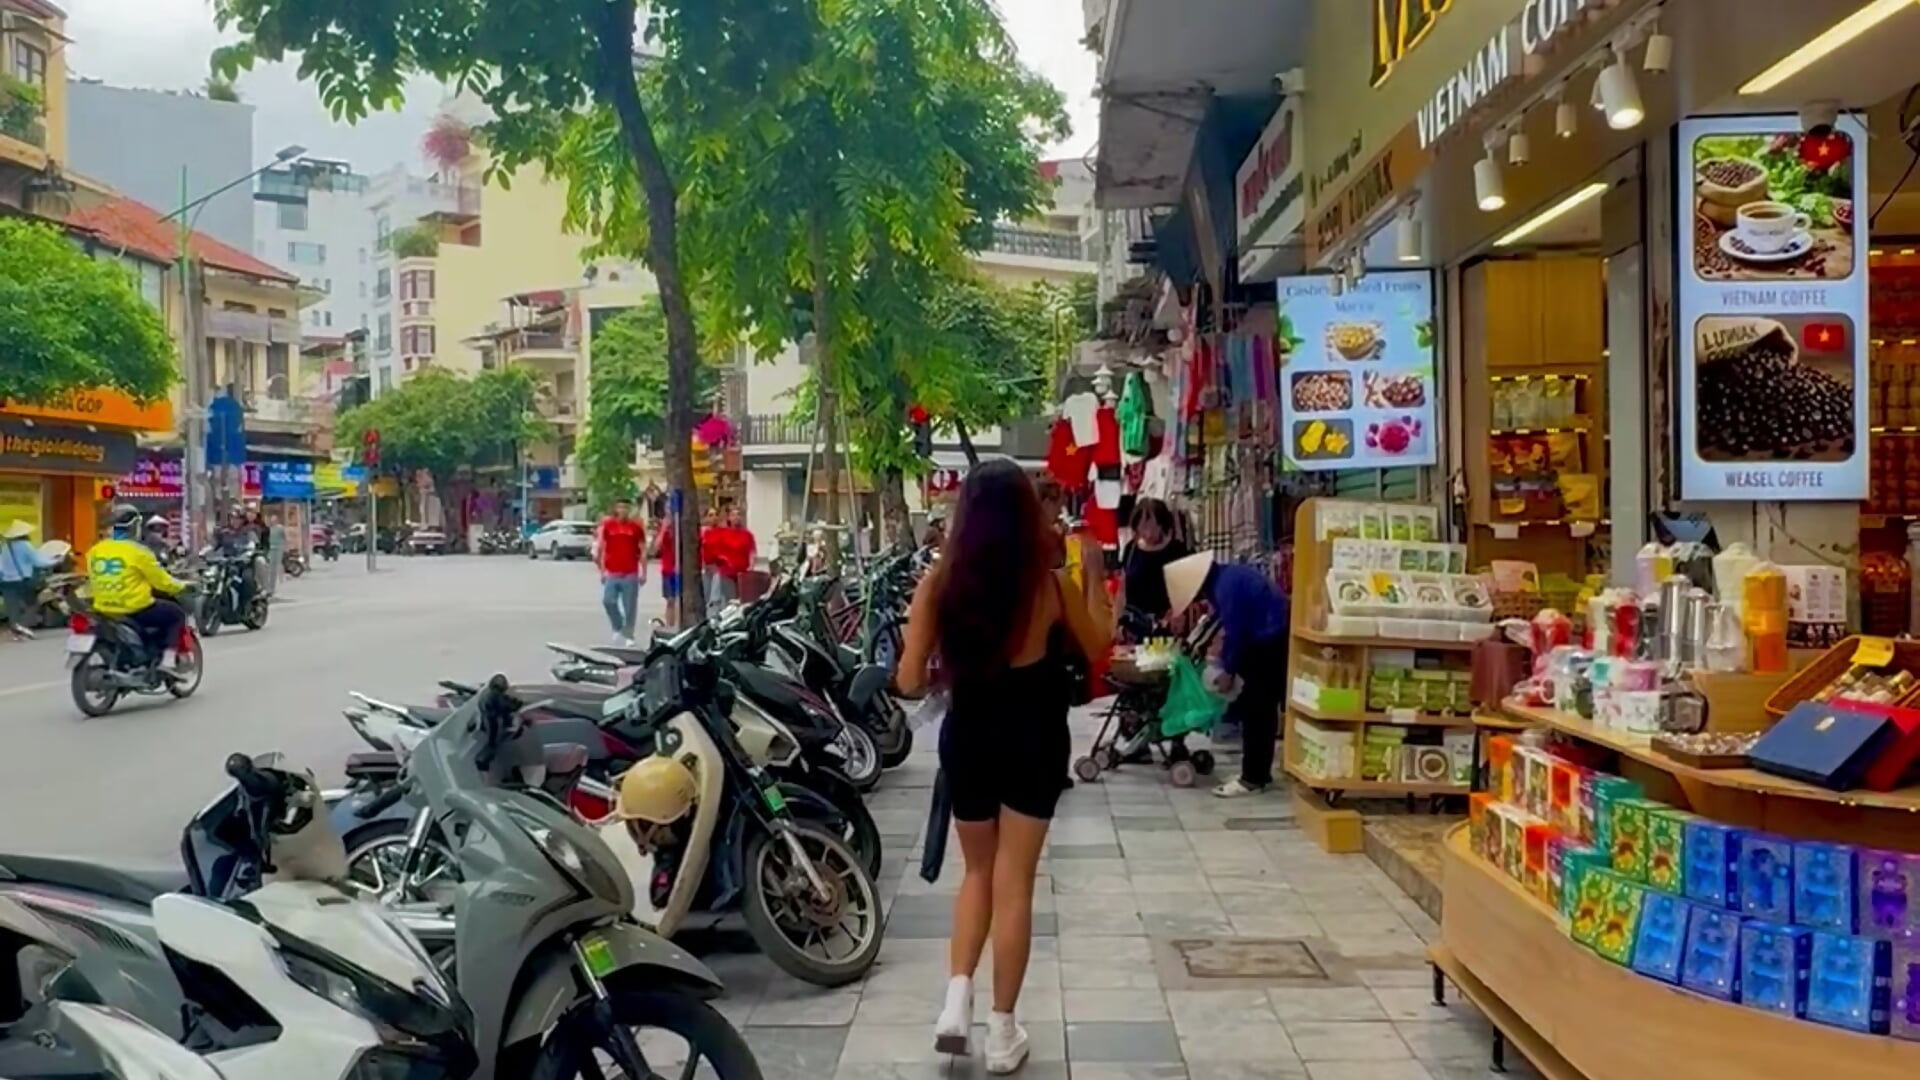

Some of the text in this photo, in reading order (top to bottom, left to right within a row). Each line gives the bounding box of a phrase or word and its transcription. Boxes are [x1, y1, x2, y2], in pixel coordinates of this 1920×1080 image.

[1417, 25, 1508, 150] VIETNAM
[1721, 289, 1827, 306] VIETNAM COFFEE
[1702, 323, 1760, 351] LUWAK
[1725, 471, 1824, 487] WEASEL COFFEE
